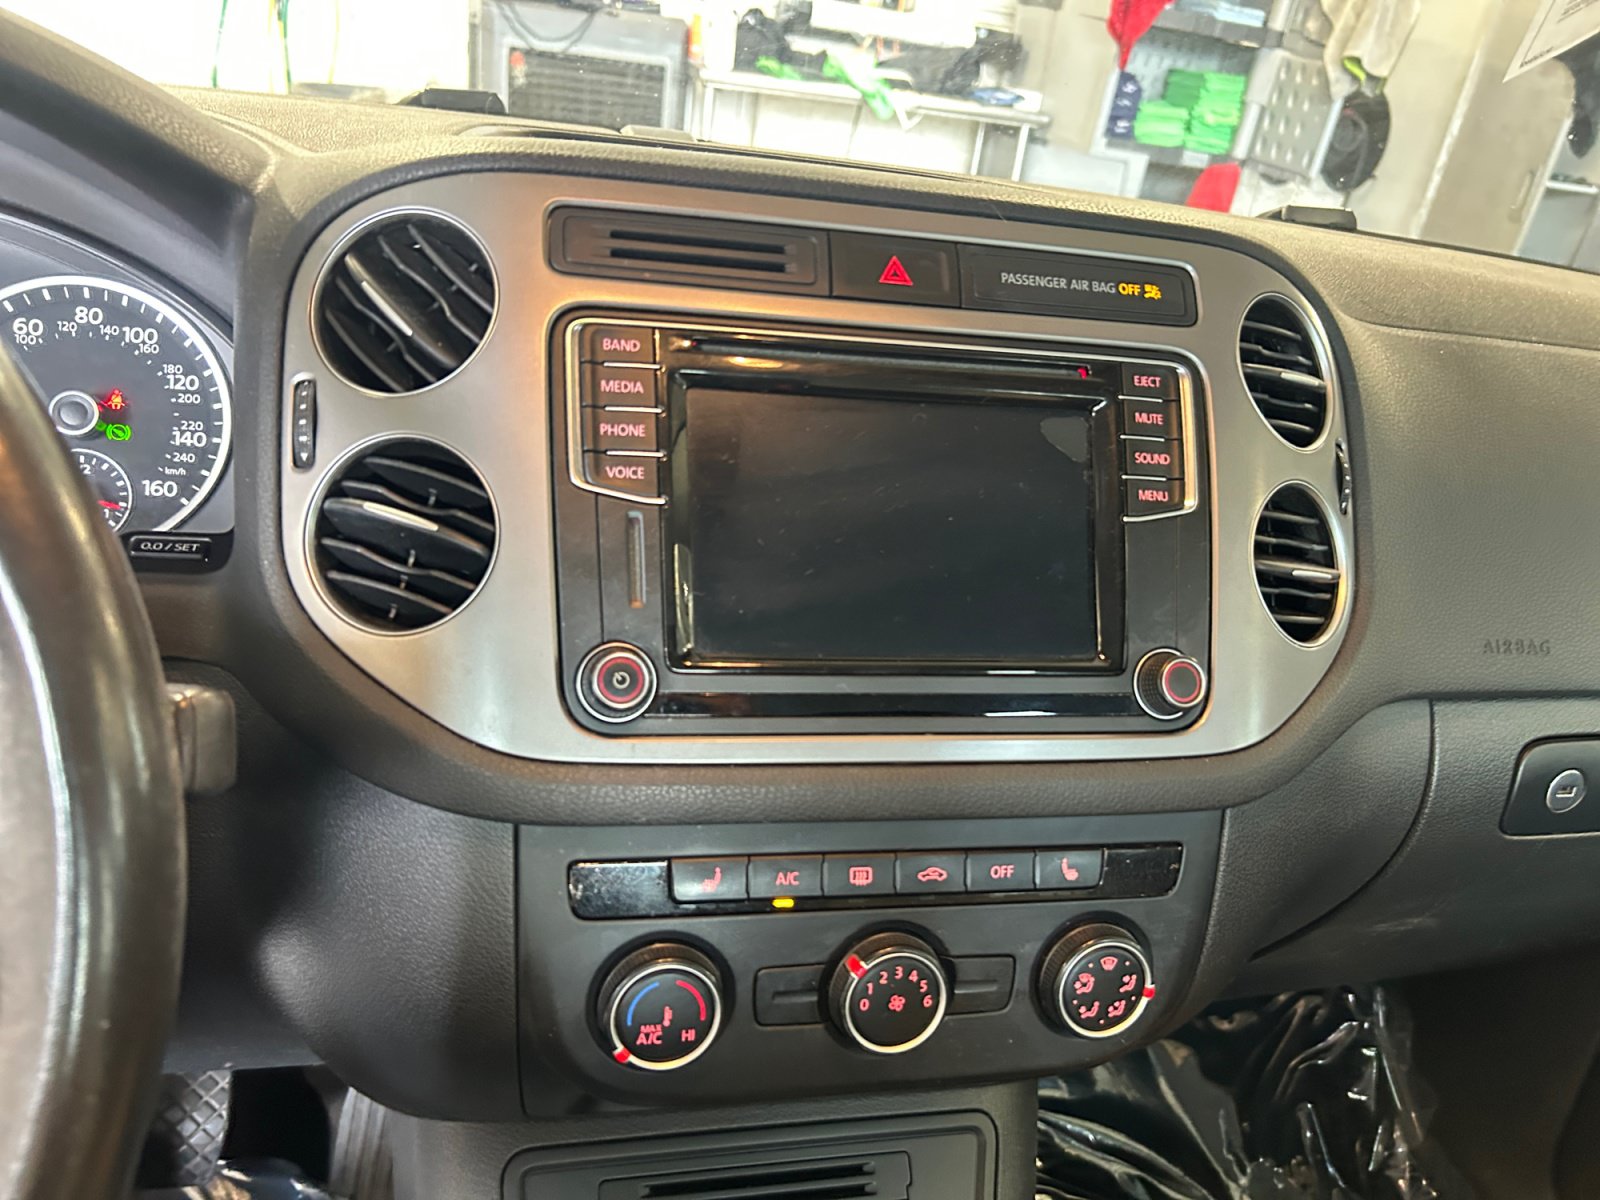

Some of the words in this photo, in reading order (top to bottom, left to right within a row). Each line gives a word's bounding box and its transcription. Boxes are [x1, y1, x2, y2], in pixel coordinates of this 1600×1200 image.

[1001, 272, 1067, 289] PASSENGER
[1070, 280, 1089, 292] AIR
[1092, 280, 1116, 294] BAG
[1118, 282, 1141, 296] OFF
[75, 306, 103, 325] 80
[13, 317, 44, 336] 60
[57, 321, 78, 332] 120
[100, 325, 120, 335] 140
[14, 333, 37, 345] 100
[122, 326, 158, 344] 100
[139, 343, 160, 354] 160
[603, 338, 641, 352] BAND
[163, 364, 183, 374] 180
[166, 375, 200, 391] 120
[600, 379, 644, 394] MEDIA
[1134, 375, 1161, 388] EJECT
[177, 393, 201, 404] 200
[1135, 412, 1164, 425] MUTE
[181, 421, 204, 431] 220
[600, 423, 646, 437] PHONE
[172, 431, 207, 447] 140
[173, 452, 196, 463] 240
[1134, 452, 1170, 465] SOUND
[164, 466, 186, 476] km/h
[606, 466, 645, 479] VOICE
[141, 480, 178, 497] 160
[1138, 490, 1169, 502] MENU
[1483, 638, 1551, 655] AIRBAG
[776, 871, 800, 886] A/C
[990, 865, 1015, 879] OFF
[879, 971, 888, 984] 2
[894, 966, 904, 979] 3
[908, 970, 918, 982] 4
[866, 982, 873, 995] 1
[919, 980, 928, 992] 5
[859, 998, 870, 1011] 0
[922, 994, 933, 1008] 6
[636, 1031, 663, 1045] A/C
[681, 1028, 696, 1041] HI
